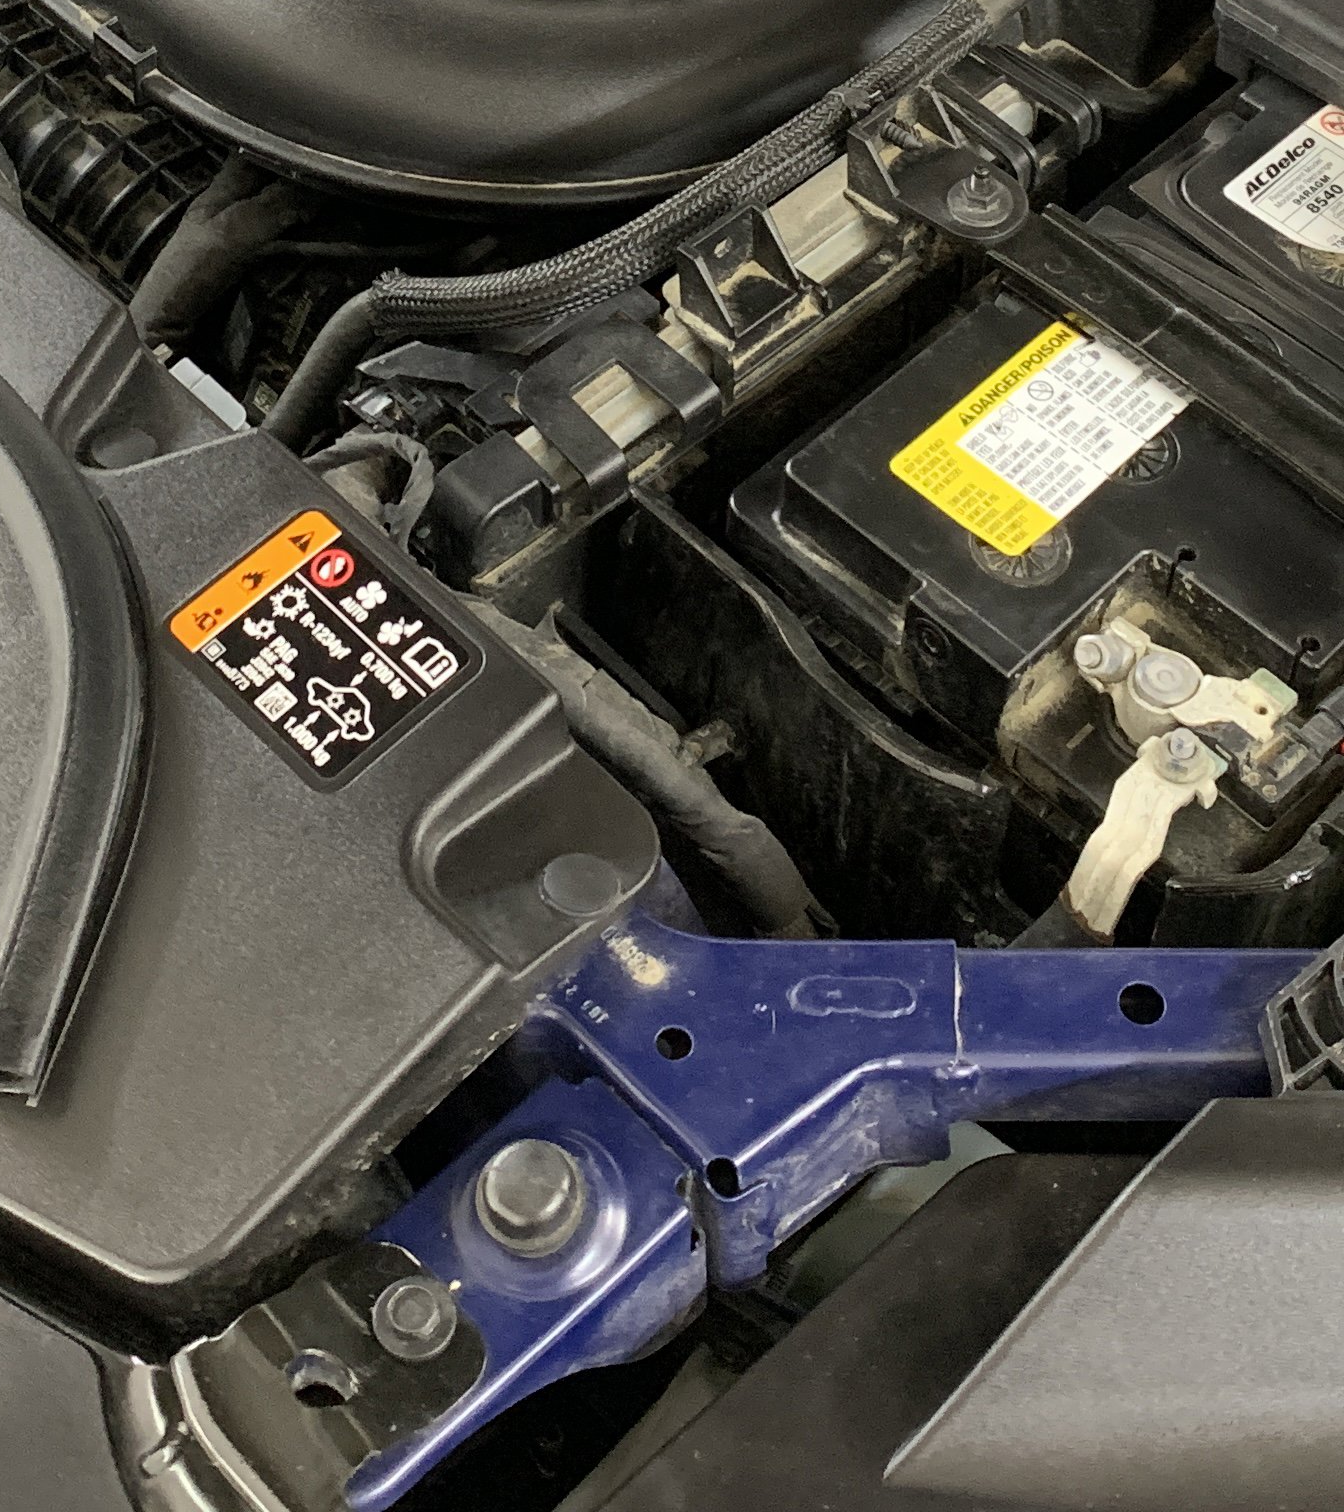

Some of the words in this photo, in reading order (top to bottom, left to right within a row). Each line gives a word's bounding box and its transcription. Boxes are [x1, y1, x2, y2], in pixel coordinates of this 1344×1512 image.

[1245, 137, 1315, 197] ACDelco
[1292, 175, 1330, 205] 94RAGM
[1306, 184, 1344, 213] 8540
[970, 329, 1073, 416] DANGER/POISON
[339, 596, 370, 623] AUTO
[269, 636, 299, 663] PAG
[298, 611, 353, 660] R-1234yf
[359, 651, 395, 684] 0.700
[385, 679, 408, 701] kg
[282, 716, 318, 751] 1.000
[309, 743, 331, 767] kg
